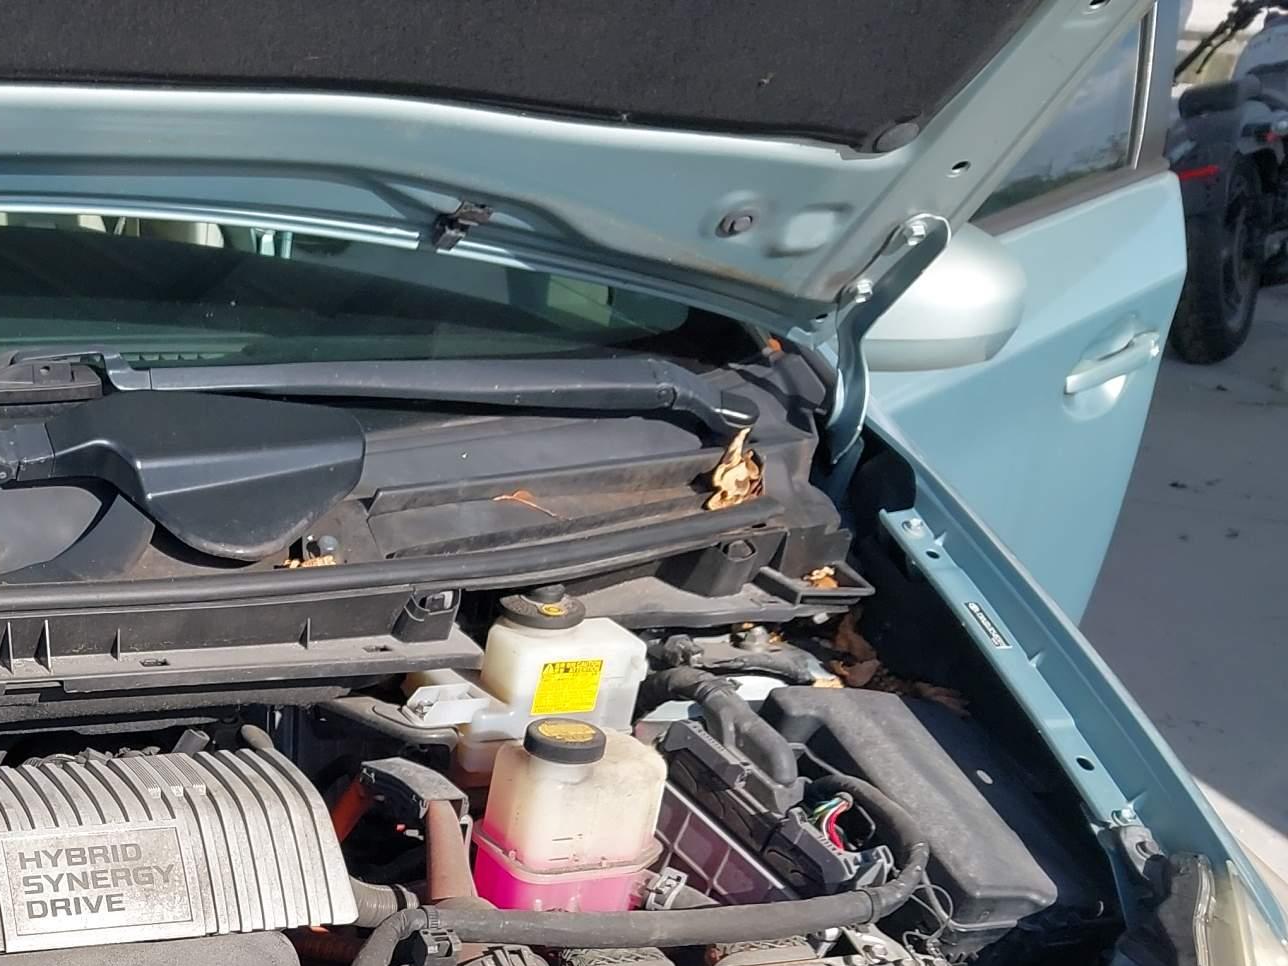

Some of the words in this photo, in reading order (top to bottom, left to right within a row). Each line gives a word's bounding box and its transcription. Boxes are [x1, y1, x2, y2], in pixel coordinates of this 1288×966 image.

[18, 843, 142, 870] HYBRID
[22, 864, 175, 895] SYNERGY
[26, 893, 126, 920] DRIVE
